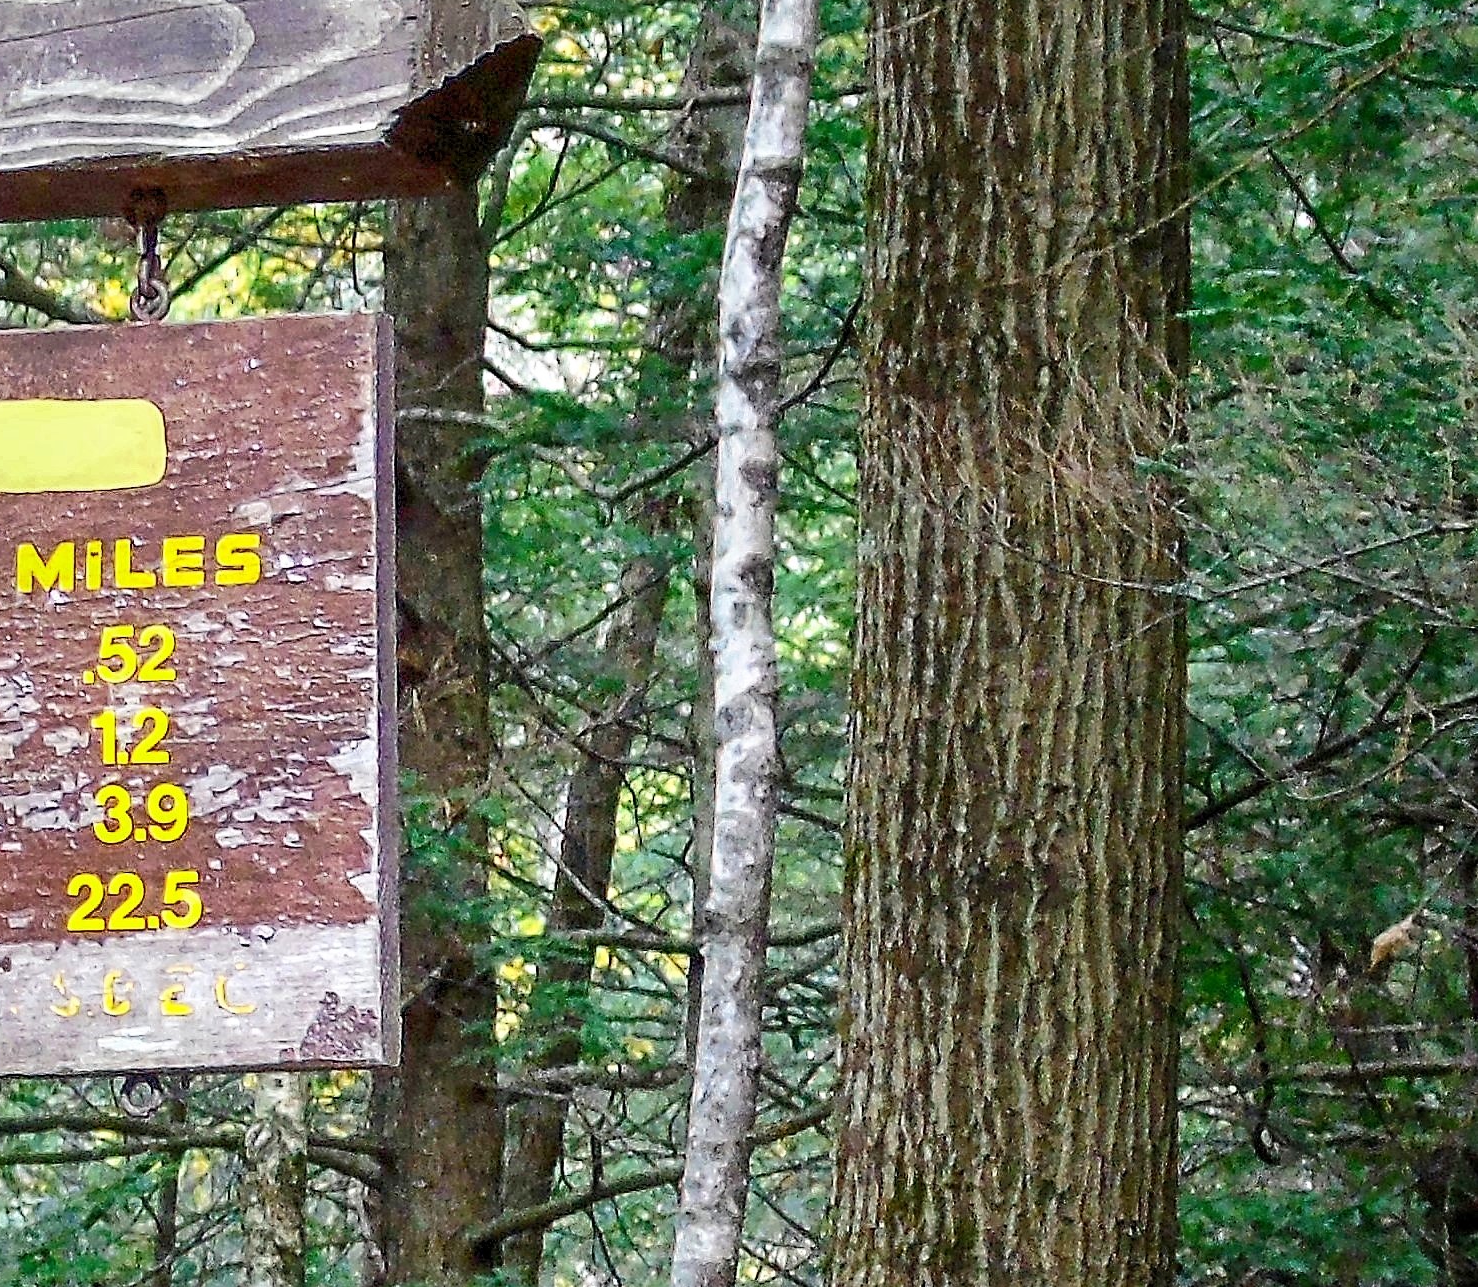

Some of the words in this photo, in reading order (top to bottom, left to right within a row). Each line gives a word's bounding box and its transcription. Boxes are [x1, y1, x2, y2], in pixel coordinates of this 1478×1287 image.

[83, 623, 178, 688] .52
[92, 706, 173, 767] 1.2
[92, 780, 191, 846] 3.9
[65, 867, 205, 934] 22.5
